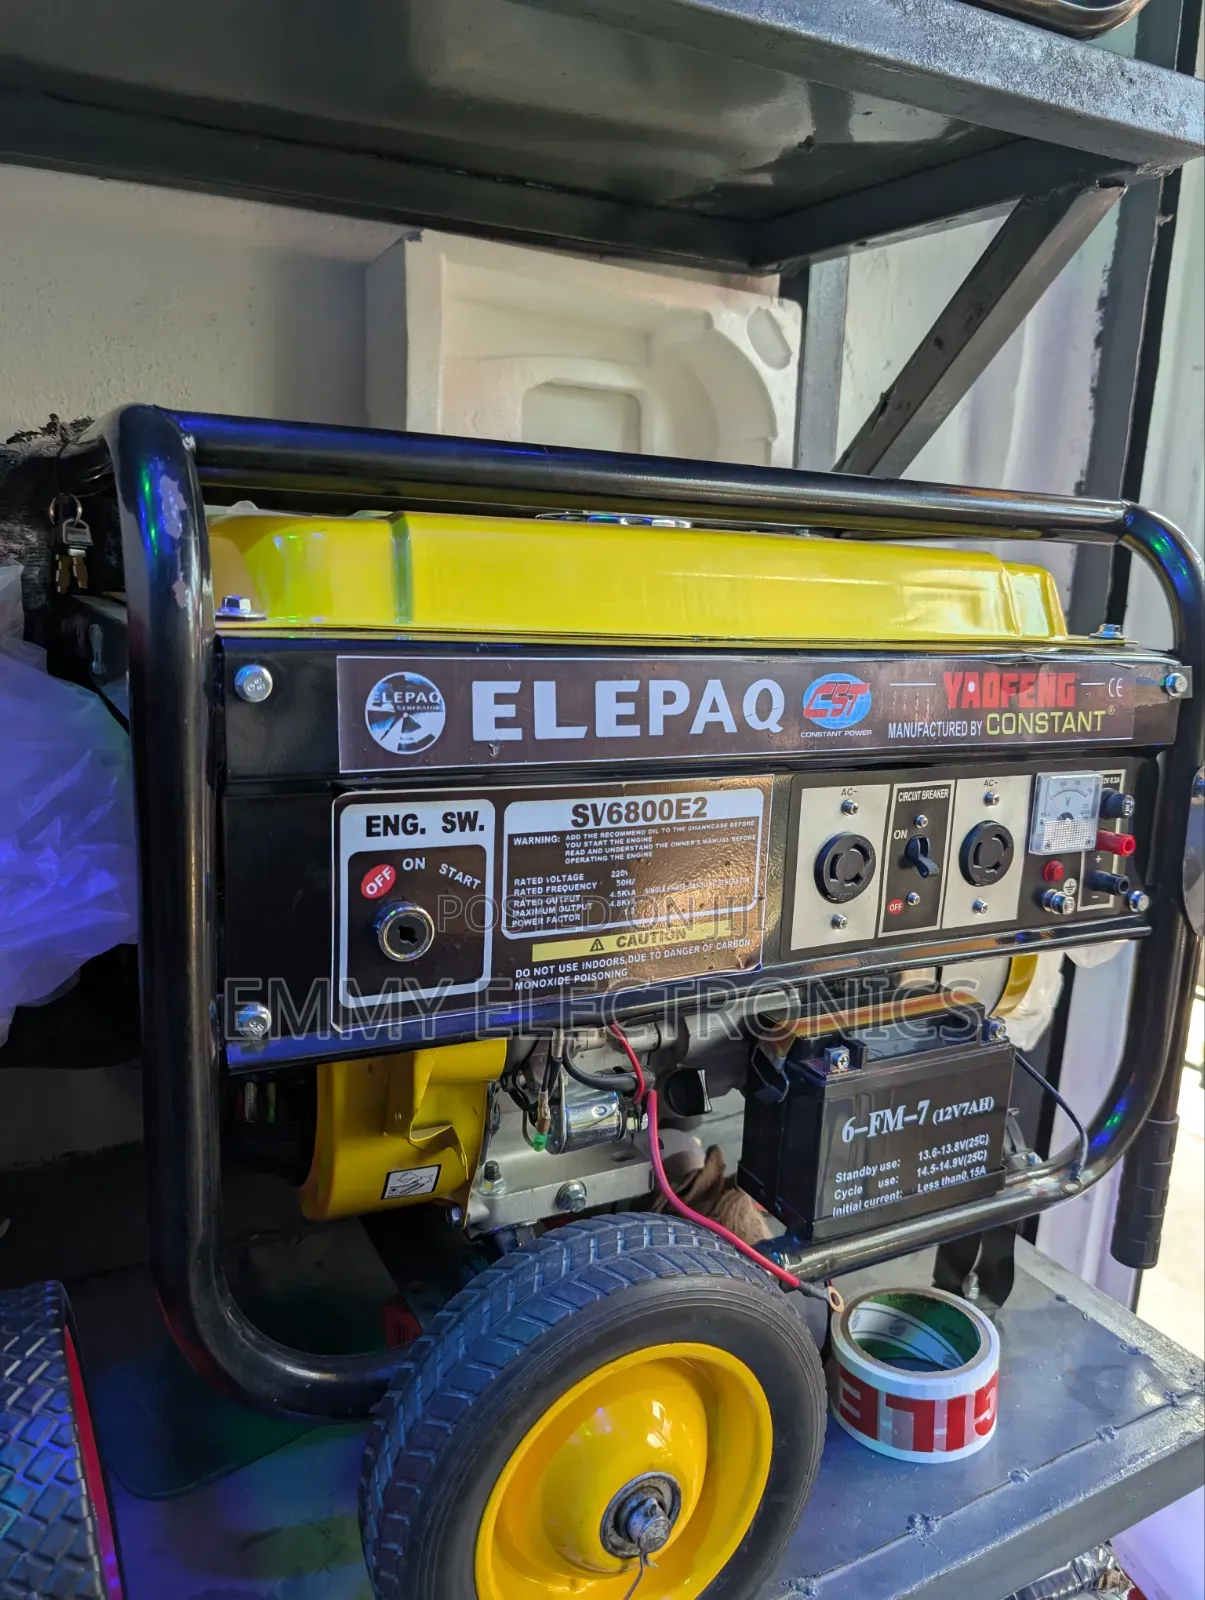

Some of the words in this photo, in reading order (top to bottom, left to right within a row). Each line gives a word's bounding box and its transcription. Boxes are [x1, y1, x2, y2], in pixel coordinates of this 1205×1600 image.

[372, 691, 441, 704] ELEPAQ
[943, 672, 1077, 710] YAOFENG
[471, 678, 786, 742] ELEPAQ
[887, 721, 968, 739] MANUFACTURED
[970, 720, 983, 737] BY
[986, 709, 1106, 736] CONSTANT
[800, 730, 843, 738] CONSTANT
[844, 729, 872, 737] POWER
[898, 790, 921, 802] CIRCUIT
[922, 788, 949, 801] BREAKER
[570, 797, 708, 828] SV6800E2
[365, 813, 426, 838] ENG.
[441, 810, 485, 834] SW.
[600, 829, 647, 838] RECOMMEND
[729, 820, 755, 828] BEFORE
[513, 835, 561, 846] WARNING:
[626, 836, 653, 844] ENGINE
[893, 829, 908, 840] ON
[604, 844, 654, 853] UNDERSTAND
[402, 857, 426, 871] ON
[564, 856, 608, 864] OPERATING
[626, 851, 653, 859] ENGINE
[365, 866, 393, 896] OFF
[438, 863, 482, 890] START
[514, 877, 543, 886] RATED
[513, 887, 543, 896] RATED
[545, 882, 597, 894] FREQUENCY
[513, 897, 543, 907] RATED
[545, 894, 581, 904] OUTPUT
[889, 902, 903, 912] OFF
[512, 907, 556, 918] MAXIMUM
[558, 902, 593, 912] OUTPUT
[512, 917, 544, 927] POWER
[546, 913, 581, 923] FACTOR
[616, 928, 687, 949] CAUTION
[515, 968, 531, 979] DO
[533, 965, 556, 976] NOT
[558, 962, 579, 973] USE
[628, 954, 647, 964] DUE
[649, 951, 661, 960] TO
[664, 945, 700, 958] DANGER
[702, 943, 714, 952] OF
[715, 939, 751, 951] CARBON
[514, 975, 571, 991] MONOXIDE
[574, 967, 628, 984] POISONING
[932, 1095, 995, 1126] (12V7AH)
[835, 1163, 878, 1183] Standby
[879, 1158, 901, 1172] use:
[834, 1184, 863, 1201] Cycle
[878, 1175, 899, 1189] use:
[832, 1202, 862, 1217] Initial
[863, 1190, 903, 1209] current:
[917, 1179, 940, 1193] Less
